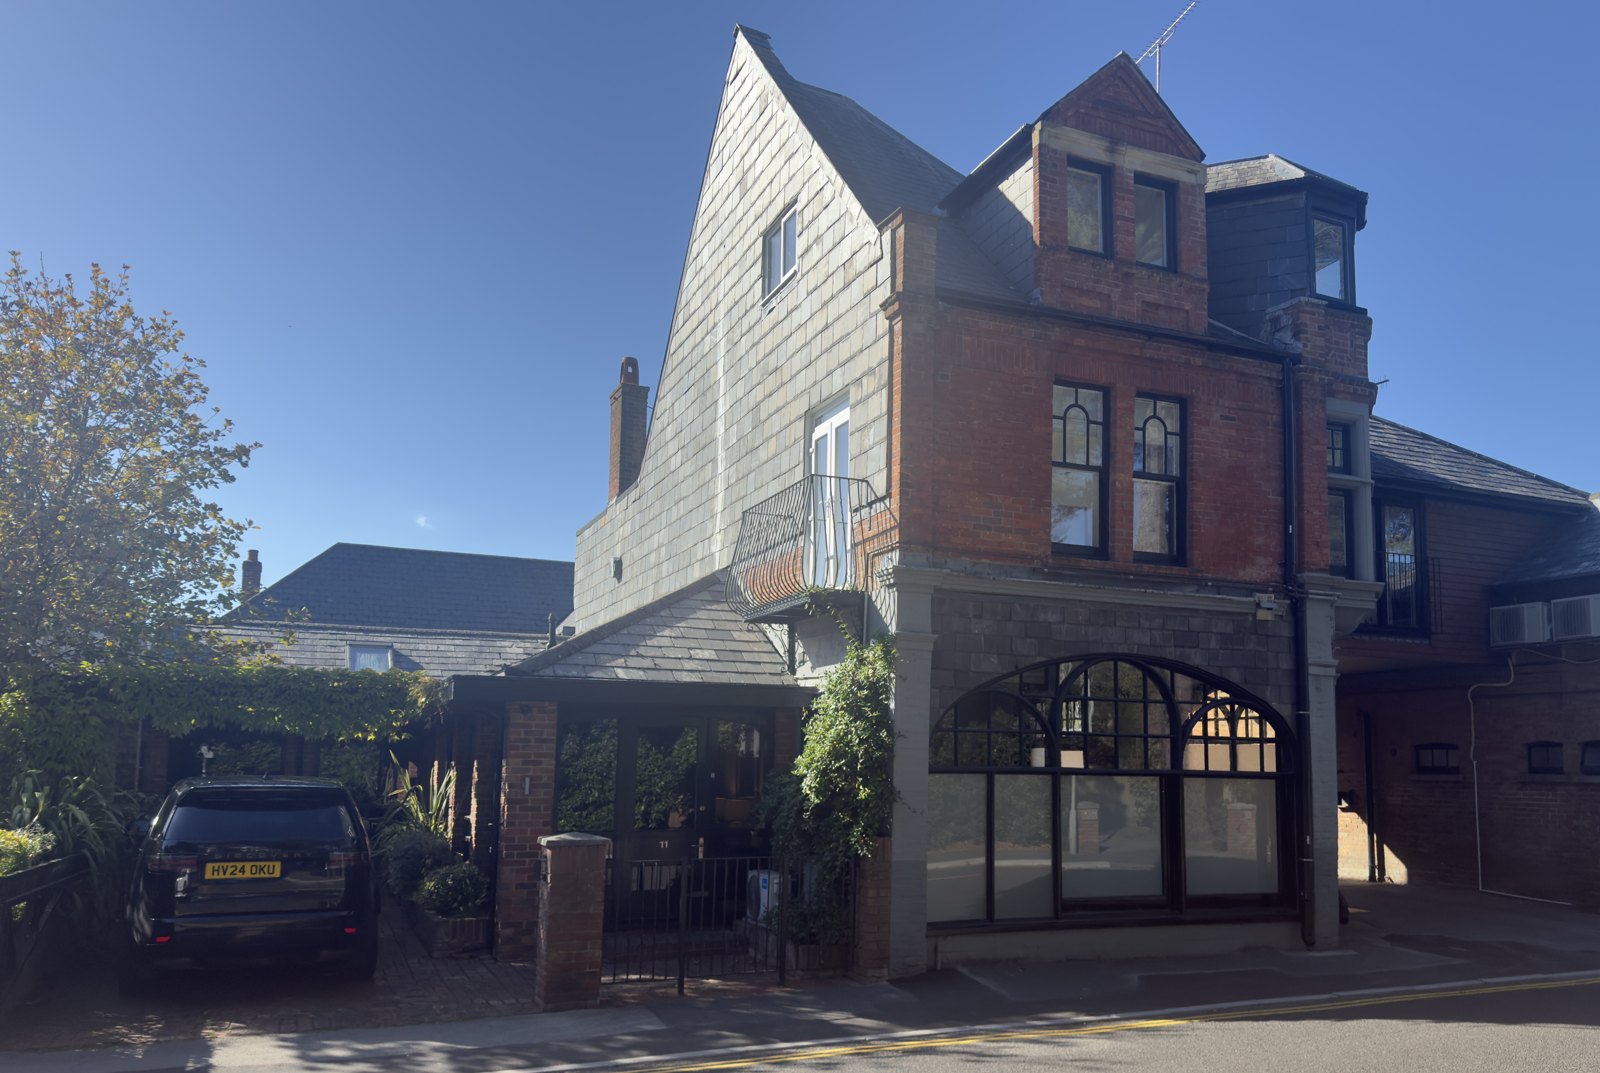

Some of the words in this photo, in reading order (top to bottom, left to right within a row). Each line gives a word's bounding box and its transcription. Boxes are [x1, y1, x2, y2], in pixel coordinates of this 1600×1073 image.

[659, 841, 668, 849] 11
[212, 865, 246, 876] HV24
[250, 864, 275, 876] OKU
